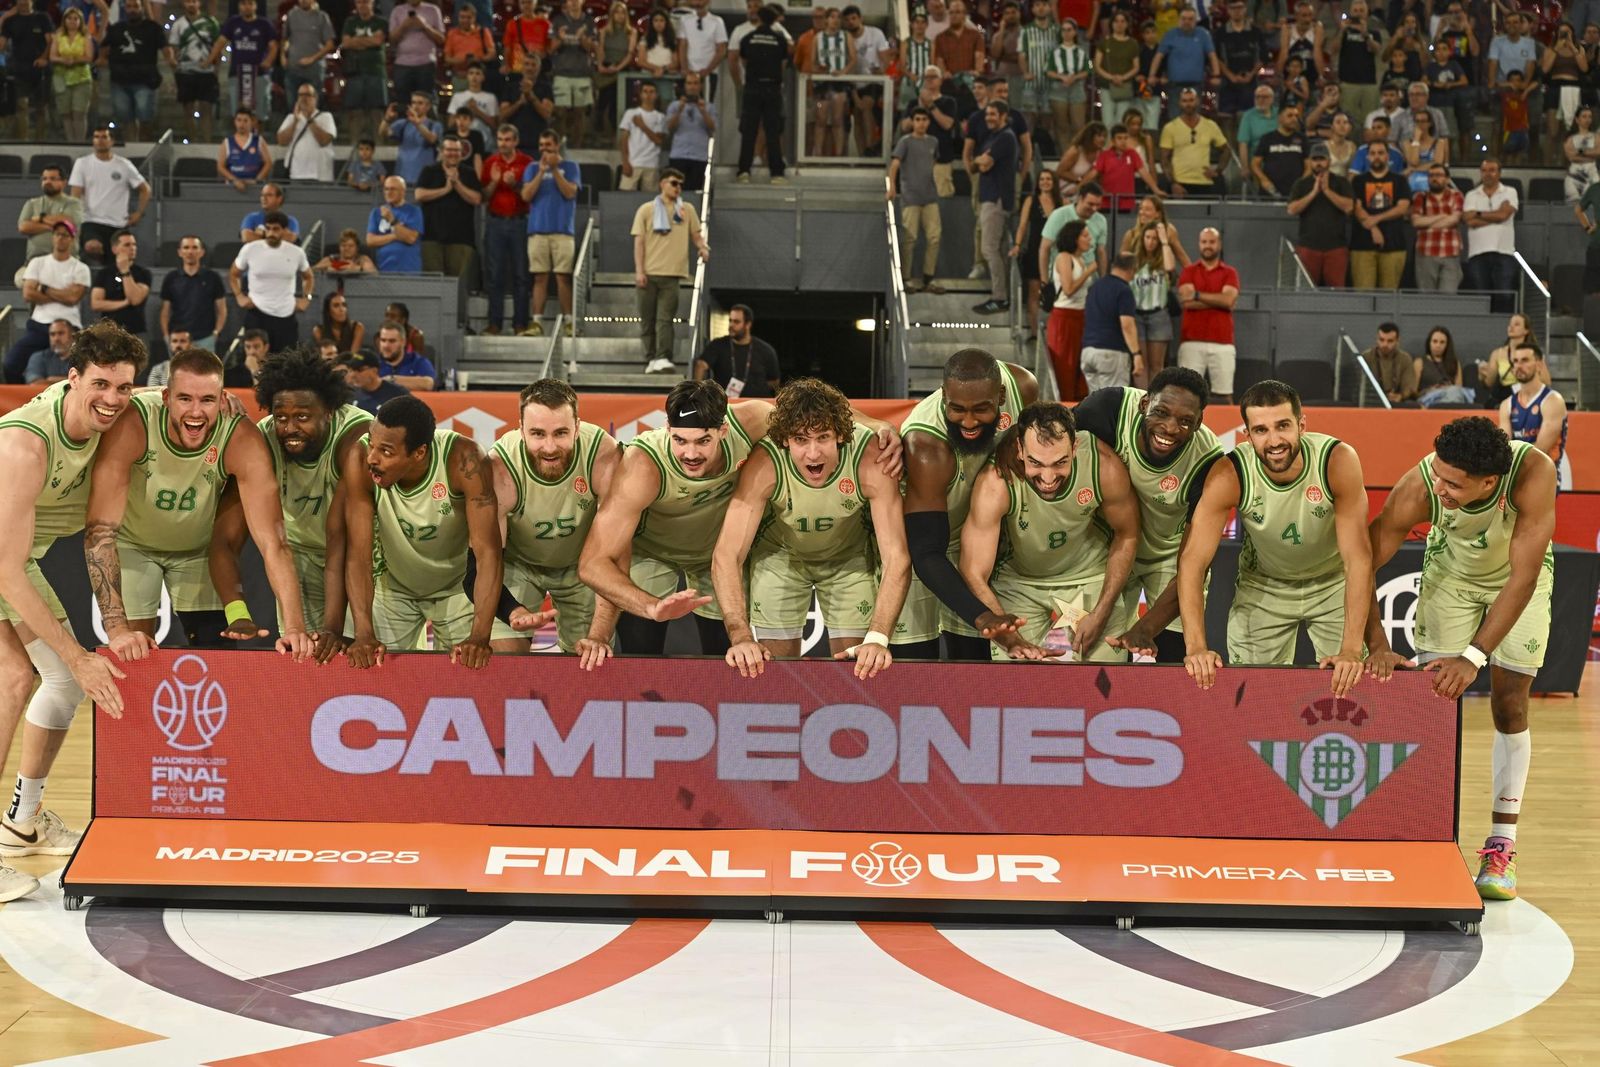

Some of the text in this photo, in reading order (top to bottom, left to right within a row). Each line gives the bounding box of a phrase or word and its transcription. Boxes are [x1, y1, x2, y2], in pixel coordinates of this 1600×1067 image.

[155, 486, 197, 511] 88
[534, 516, 576, 540] 25
[796, 517, 834, 533] 16
[1281, 522, 1302, 545] 4
[1048, 531, 1067, 549] 8
[310, 694, 1184, 788] CAMPEONES
[152, 756, 227, 765] MADRID2025
[152, 766, 227, 783] FINAL
[152, 805, 201, 813] PRIMERA
[155, 846, 421, 864] MADRID2025
[484, 845, 767, 879] FINAL
[1121, 863, 1396, 882] PRIMERA FEB
